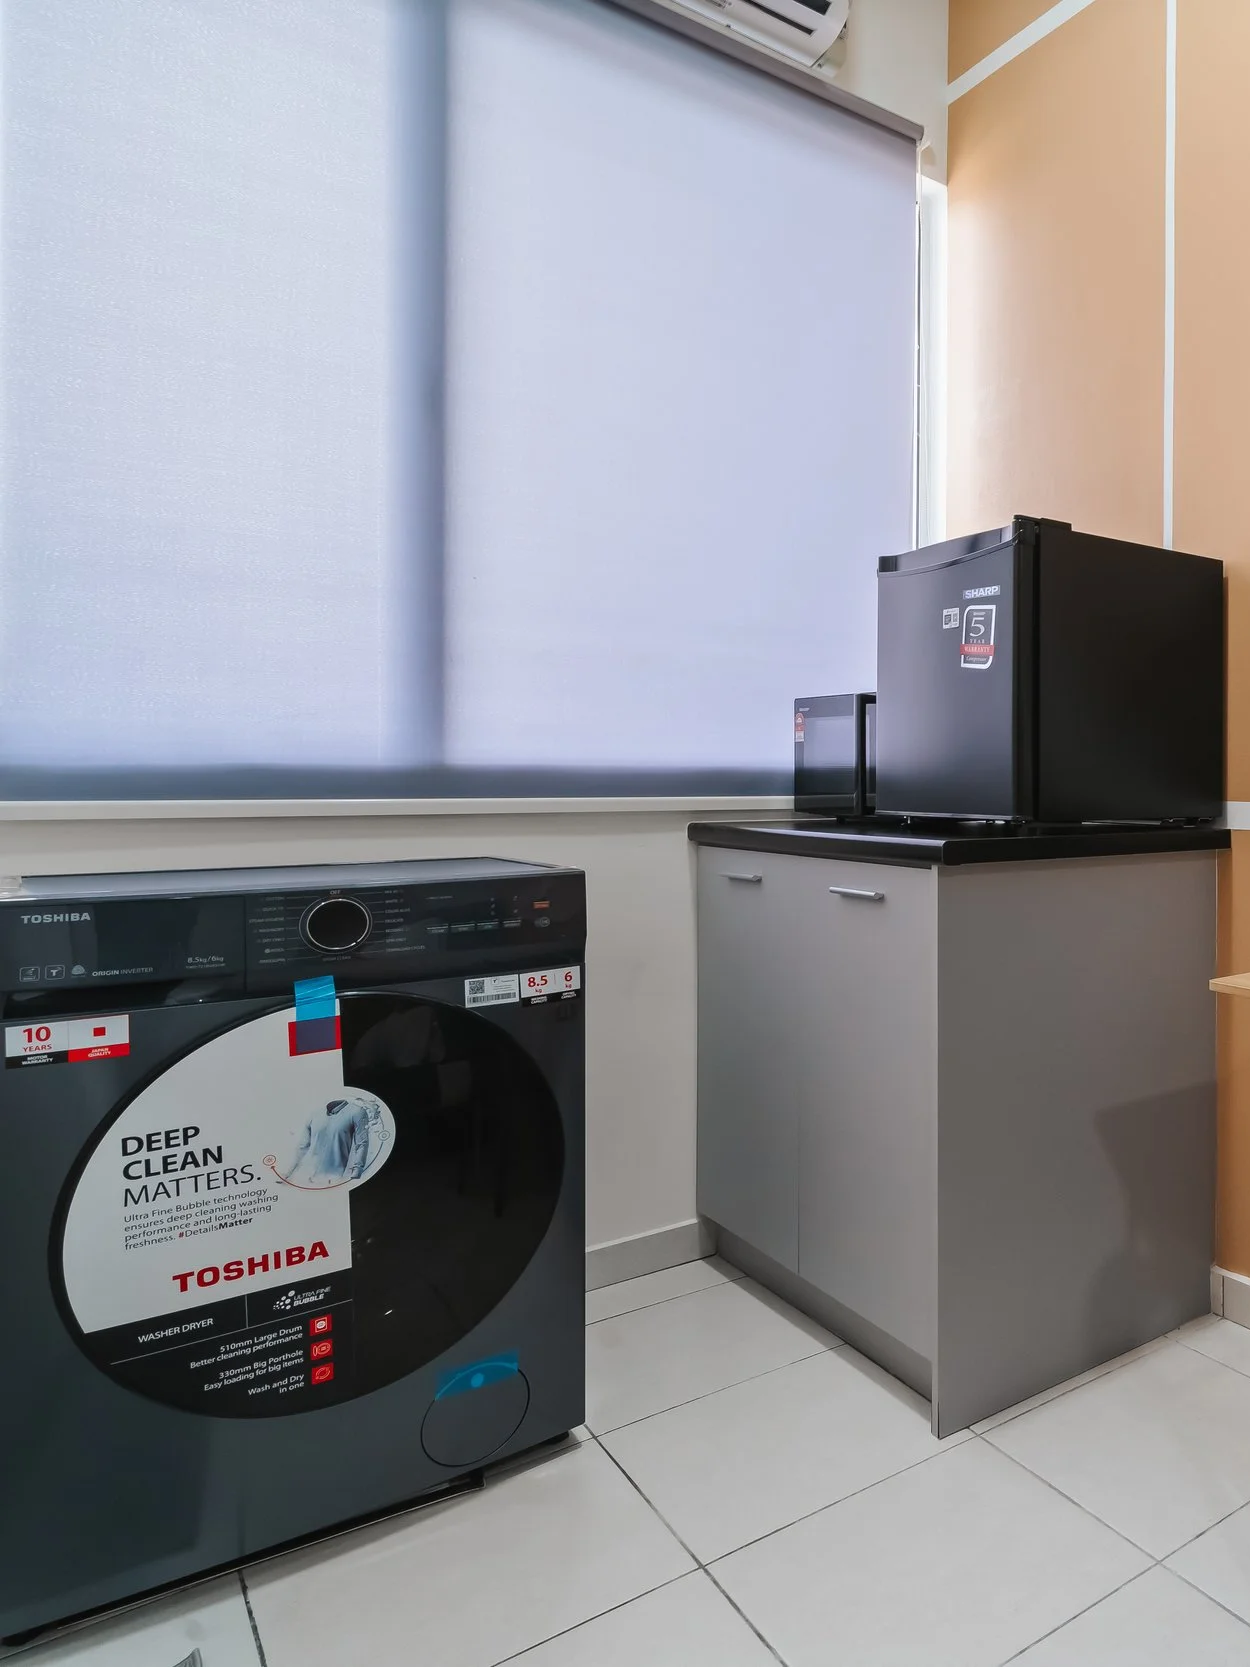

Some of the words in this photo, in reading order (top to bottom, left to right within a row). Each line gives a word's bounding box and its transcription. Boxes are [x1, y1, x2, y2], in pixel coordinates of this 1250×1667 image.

[965, 586, 999, 599] SHARP
[969, 617, 986, 637] 5
[21, 912, 91, 924] TOSHIBA
[92, 969, 120, 977] ORIGIN
[120, 966, 154, 975] INVERTER
[527, 975, 548, 988] 8.5
[564, 971, 573, 982] 6
[22, 1026, 51, 1044] 10
[23, 1044, 52, 1053] YEARS
[121, 1125, 200, 1157] DEEP
[122, 1145, 223, 1181] CLEAN
[124, 1164, 261, 1208] MATTERS.
[124, 1211, 149, 1223] Ultra
[151, 1207, 173, 1218] Fine
[175, 1198, 211, 1213] Bubble
[213, 1187, 268, 1204] technology
[124, 1218, 165, 1232] ensures
[166, 1212, 193, 1227] deep
[195, 1202, 237, 1219] cleaning
[239, 1193, 279, 1208] washing
[124, 1223, 191, 1242] performance
[193, 1216, 213, 1227] and
[214, 1203, 272, 1223] long-lasting
[124, 1234, 176, 1251] freshness.
[178, 1216, 253, 1239] #DetailsMatter
[172, 1240, 330, 1293] TOSHIBA
[293, 1293, 325, 1307] BUBBLE
[294, 1290, 315, 1300] ULTRA
[315, 1286, 331, 1296] FINE
[138, 1325, 181, 1344] WASHER
[182, 1318, 214, 1333] DRYER
[220, 1339, 253, 1353] 510mm
[254, 1331, 278, 1346] Large
[279, 1324, 303, 1338] Drum
[190, 1356, 216, 1369] Better
[216, 1346, 251, 1362] cleaning
[252, 1332, 303, 1353] performance
[219, 1365, 251, 1380] 330mm
[253, 1358, 267, 1371] Big
[268, 1348, 304, 1366] Porthole
[204, 1379, 223, 1392] Easy
[224, 1370, 255, 1386] loading
[255, 1366, 267, 1378] for
[268, 1362, 281, 1376] big
[282, 1356, 304, 1369] items
[248, 1383, 271, 1396] Wash
[272, 1377, 288, 1389] and
[289, 1373, 305, 1386] Dry
[279, 1385, 287, 1394] in
[289, 1381, 305, 1391] one
